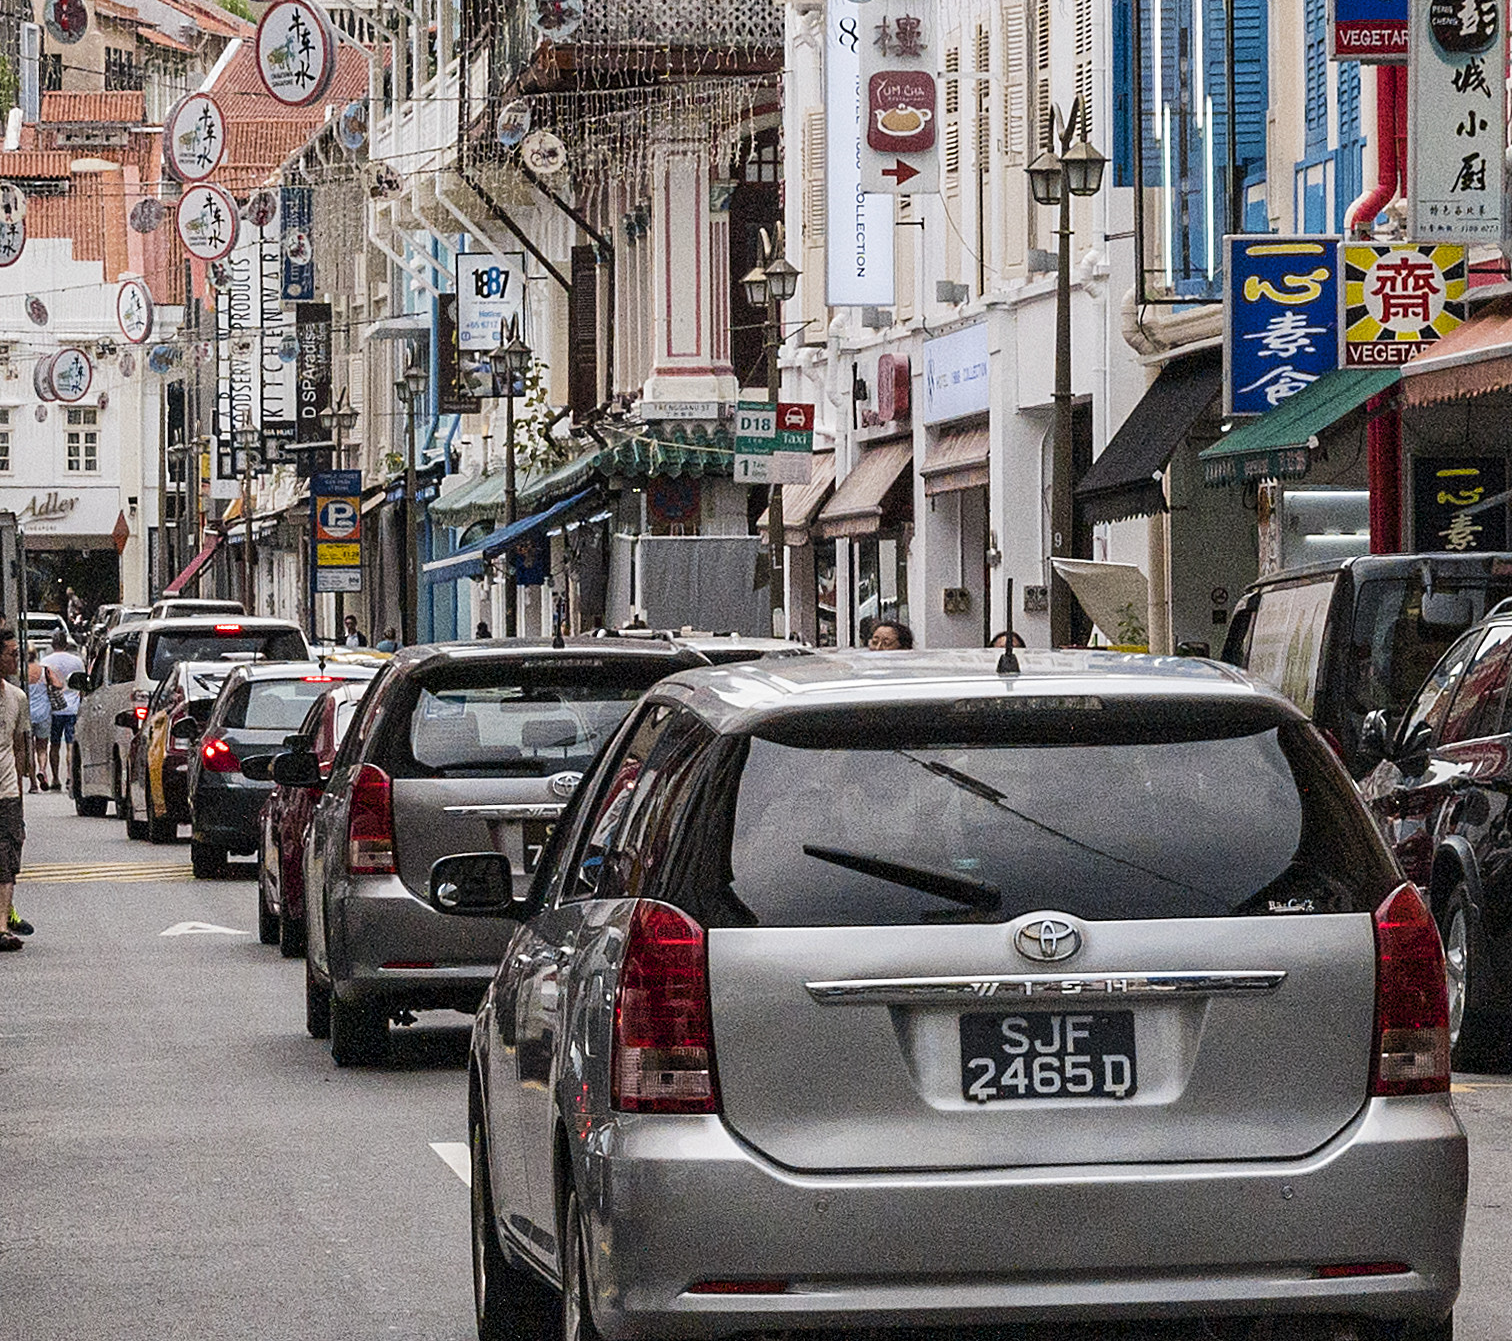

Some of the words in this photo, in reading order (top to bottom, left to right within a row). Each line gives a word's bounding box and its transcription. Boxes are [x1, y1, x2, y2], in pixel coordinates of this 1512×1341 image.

[1339, 29, 1409, 46] VEGETAR
[289, 7, 315, 89] 牛车水
[1370, 258, 1441, 324] 齋
[1349, 343, 1430, 363] VEGETA
[741, 417, 771, 431] D18
[783, 433, 807, 444] Taxi
[740, 460, 749, 476] 1
[18, 492, 79, 517] Adler
[1001, 1016, 1093, 1054] SJF
